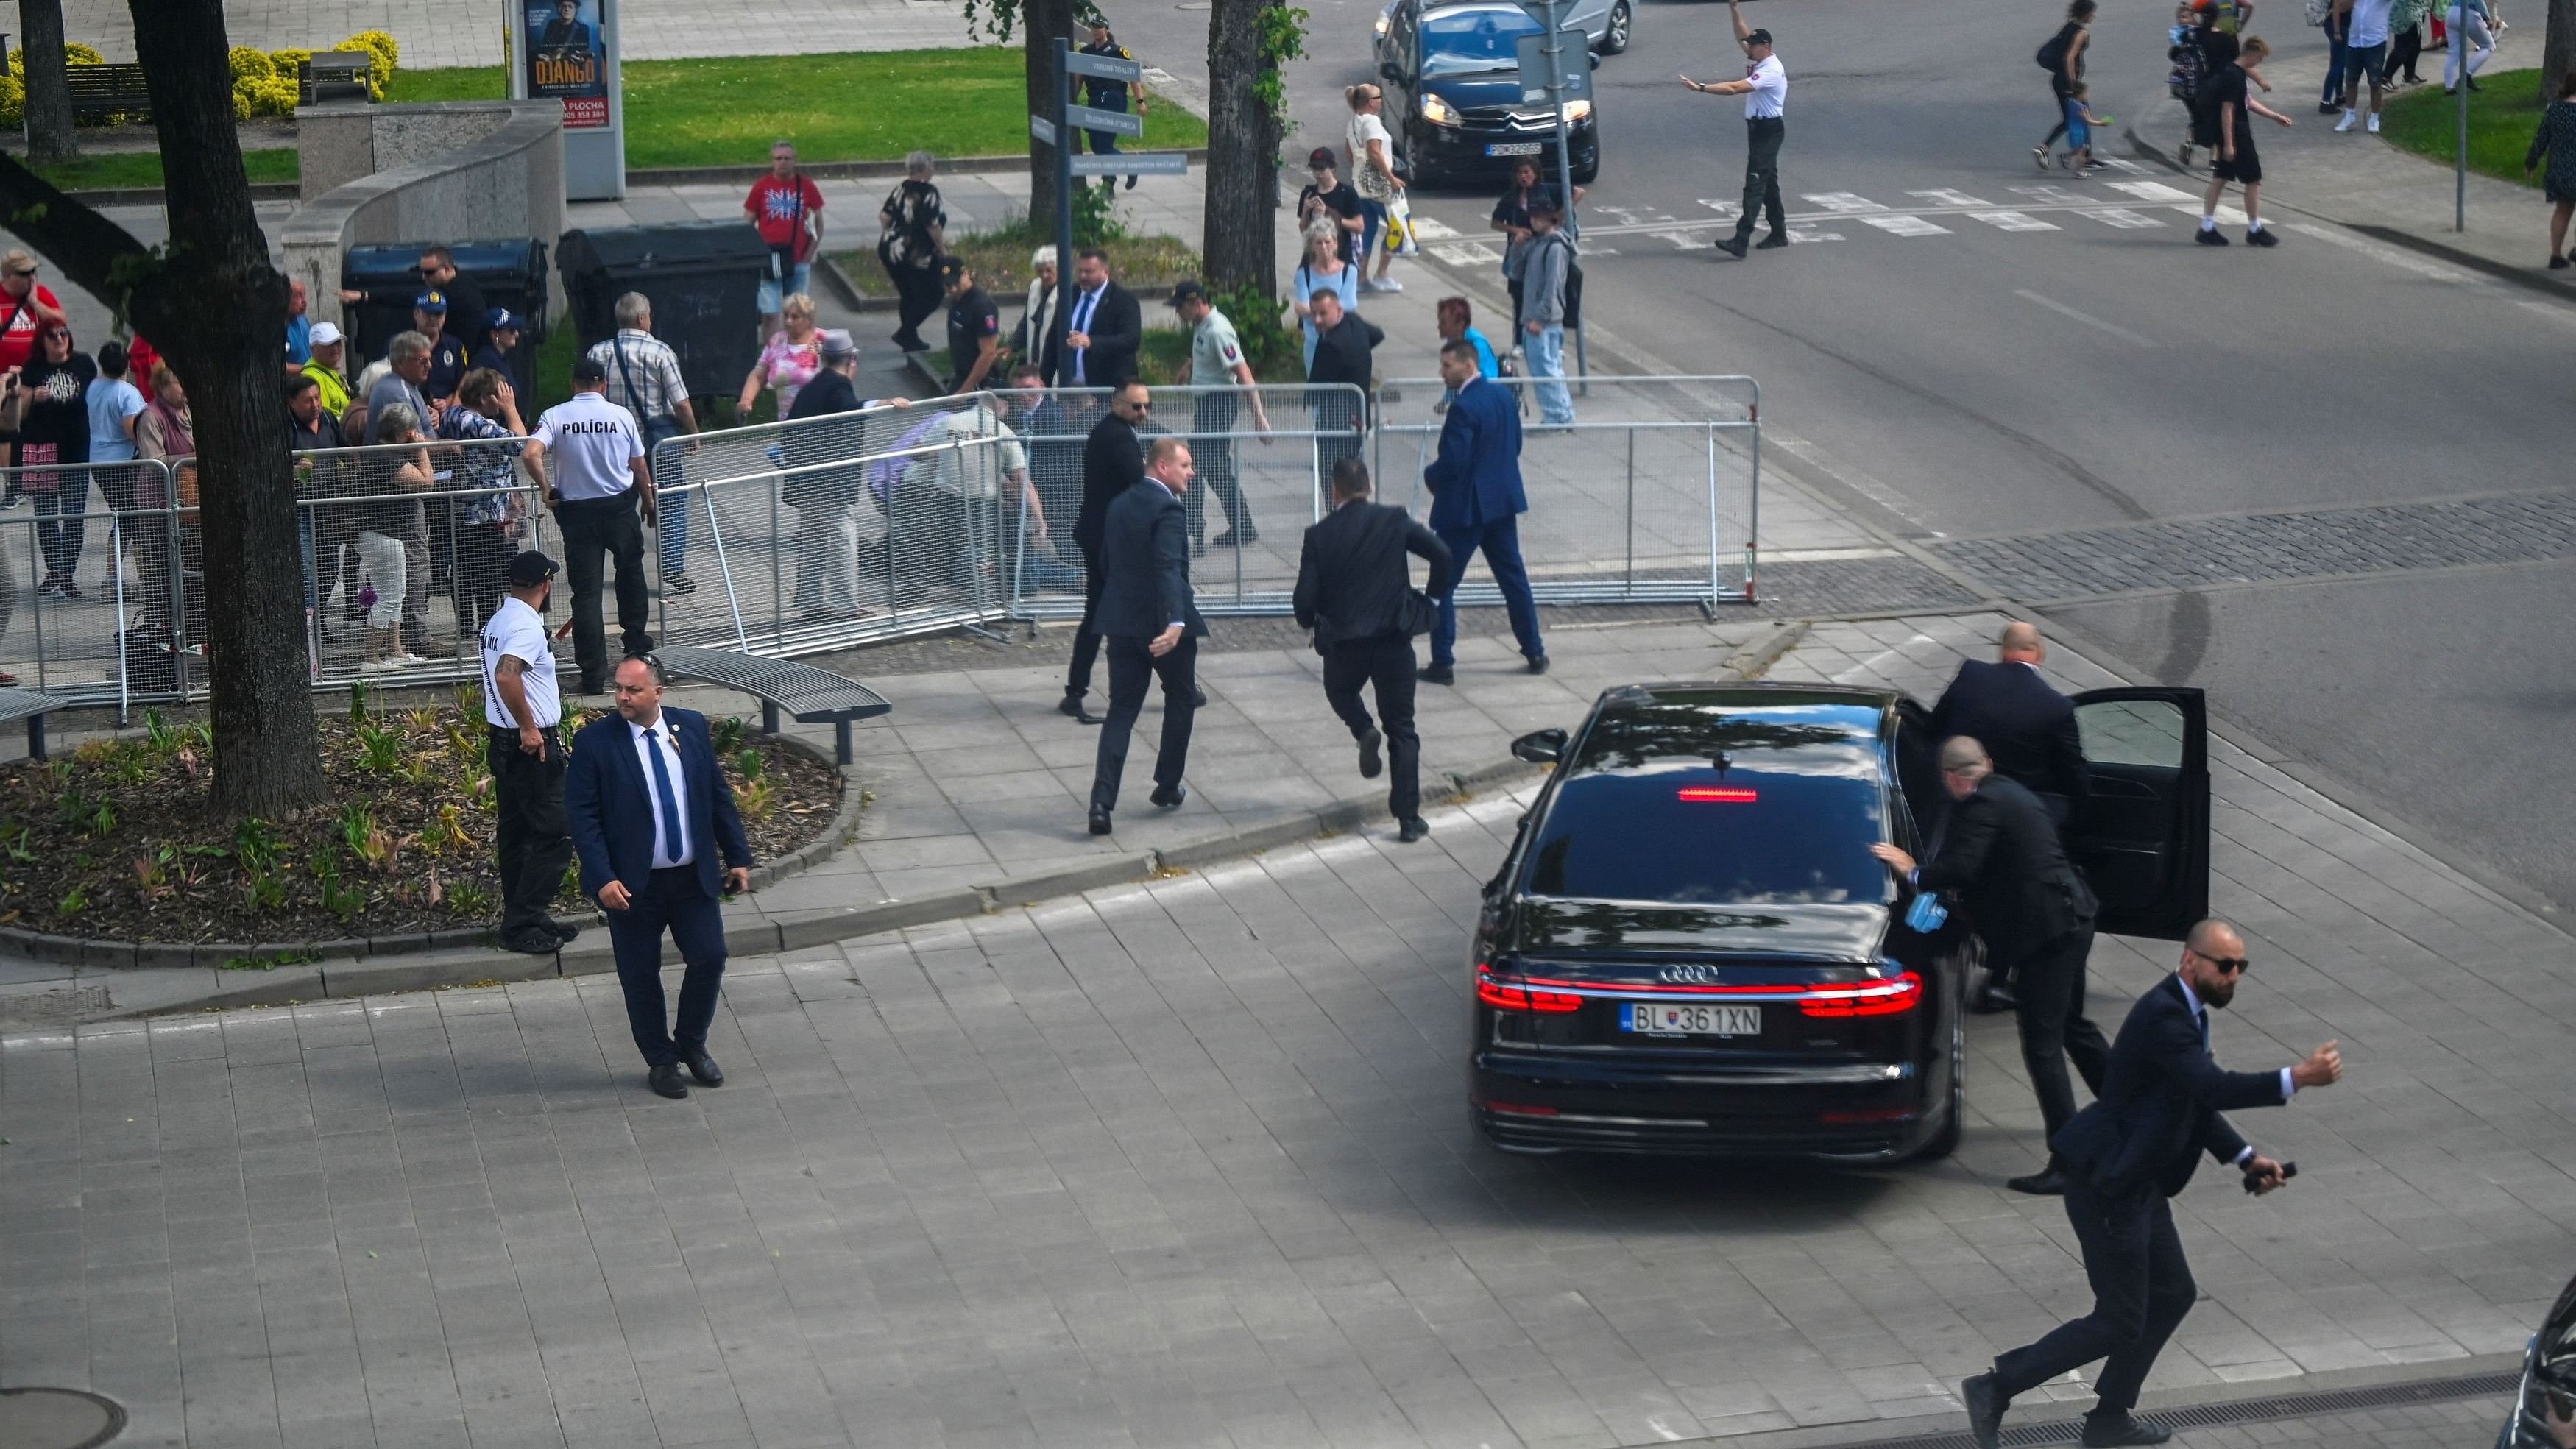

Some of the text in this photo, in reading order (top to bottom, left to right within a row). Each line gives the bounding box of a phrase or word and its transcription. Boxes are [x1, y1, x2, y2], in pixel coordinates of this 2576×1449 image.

[535, 60, 595, 84] DJANGO
[1114, 64, 1136, 75] TOALETY
[569, 102, 604, 110] PLOCHA
[562, 419, 618, 435] POLÍCIA
[1635, 1006, 1758, 1032] BL 361XN
